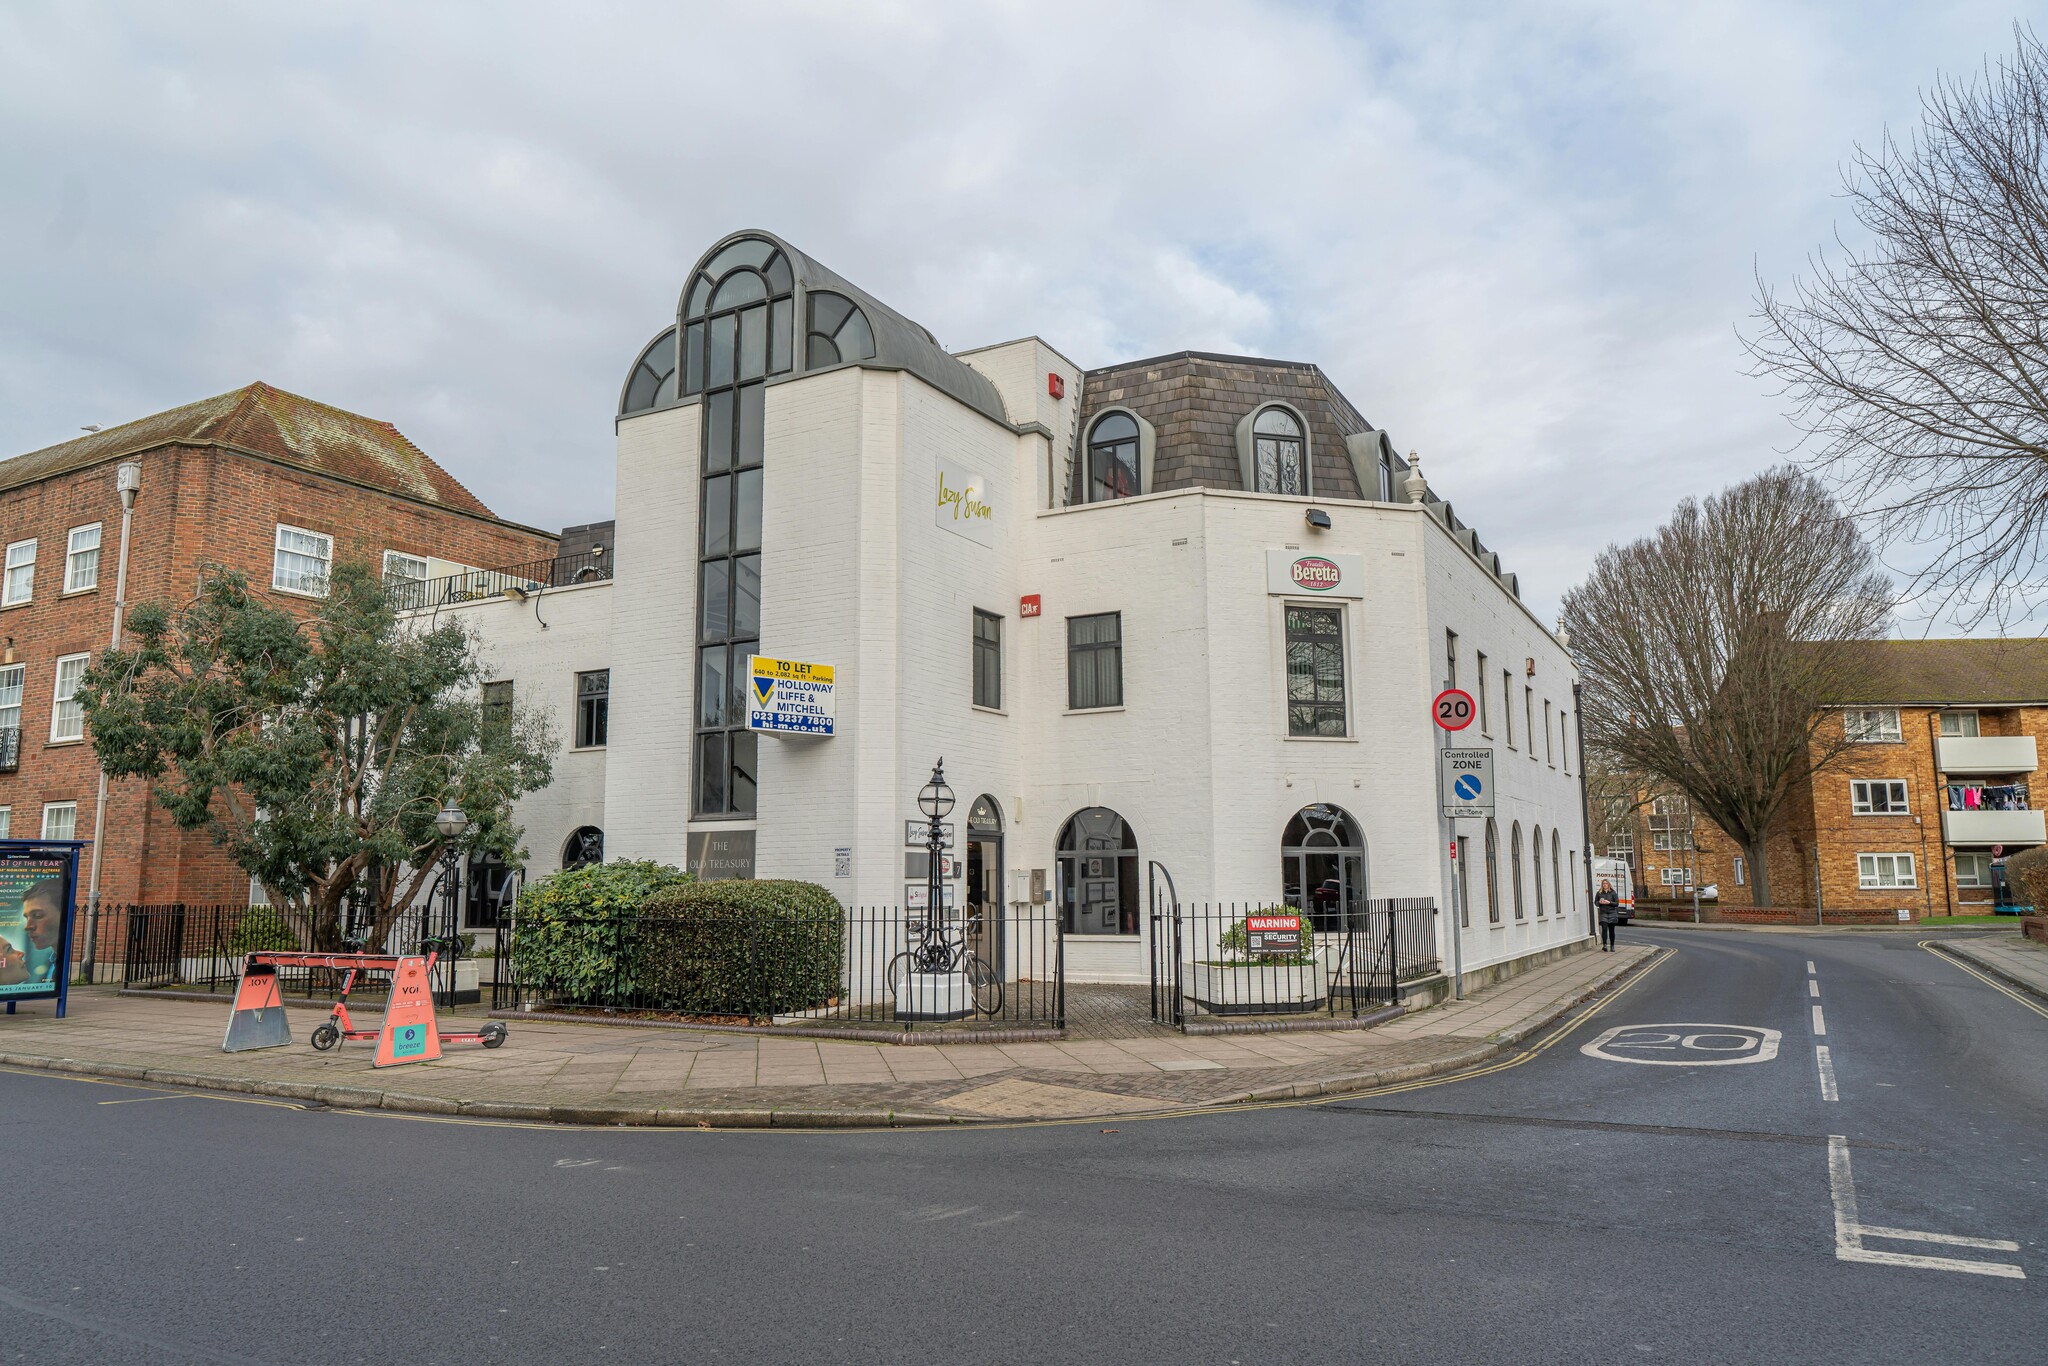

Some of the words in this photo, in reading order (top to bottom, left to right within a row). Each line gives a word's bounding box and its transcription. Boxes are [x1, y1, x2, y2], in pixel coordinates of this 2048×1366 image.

[938, 472, 963, 520] Lazy
[964, 487, 991, 520] Susan
[1293, 564, 1339, 581] Beretta
[777, 661, 790, 671] TO
[795, 664, 812, 674] LET
[813, 675, 832, 684] Parking
[777, 680, 833, 693] HOLLOWAY
[777, 691, 805, 702] ILIFFE
[808, 694, 815, 702] &
[777, 702, 825, 715] MITCHELL
[1439, 700, 1469, 718] 20
[753, 711, 773, 720] 023
[778, 714, 803, 723] 9237
[807, 717, 832, 726] 7800
[762, 721, 826, 733] hi-m.co.uk
[1444, 751, 1490, 759] Controlled
[1452, 760, 1482, 769] ZONE
[712, 841, 728, 851] THE
[689, 859, 707, 869] OLD
[710, 859, 751, 869] TREASURY
[1250, 919, 1297, 928] WARNING
[398, 1042, 421, 1051] breeze
[1606, 1032, 1759, 1051] 20
